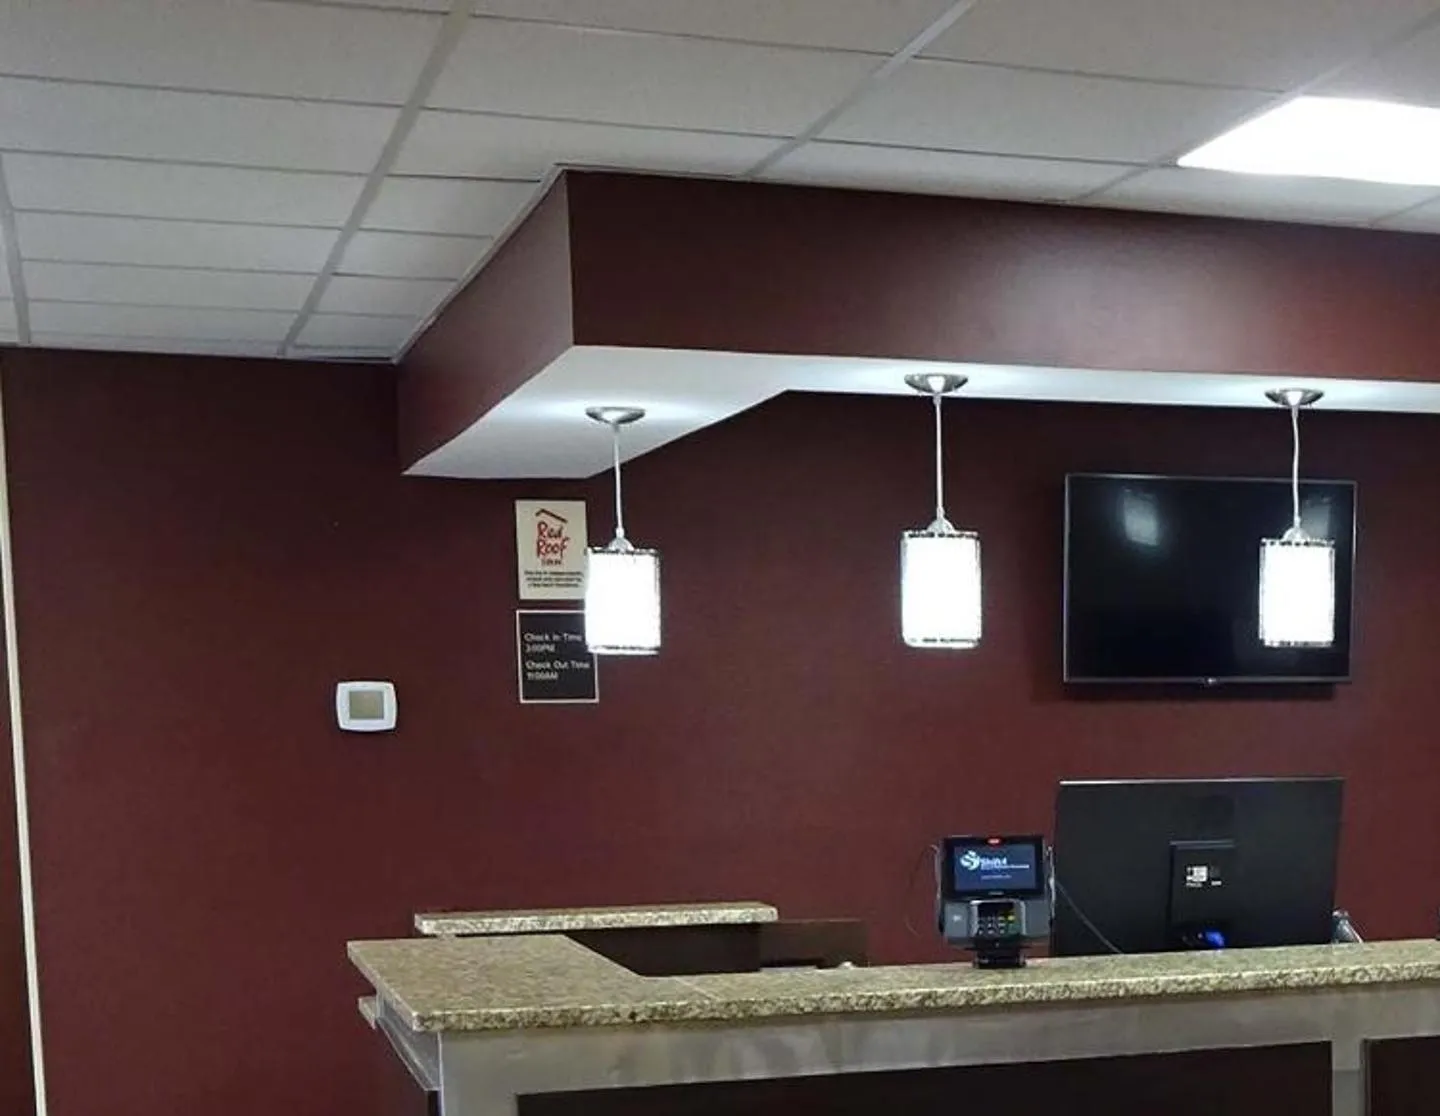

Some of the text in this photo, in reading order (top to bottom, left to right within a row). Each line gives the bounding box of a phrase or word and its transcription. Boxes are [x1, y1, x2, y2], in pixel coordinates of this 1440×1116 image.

[536, 521, 564, 538] Red
[537, 536, 570, 558] Roof
[525, 660, 551, 670] Check
[552, 660, 569, 670] Out
